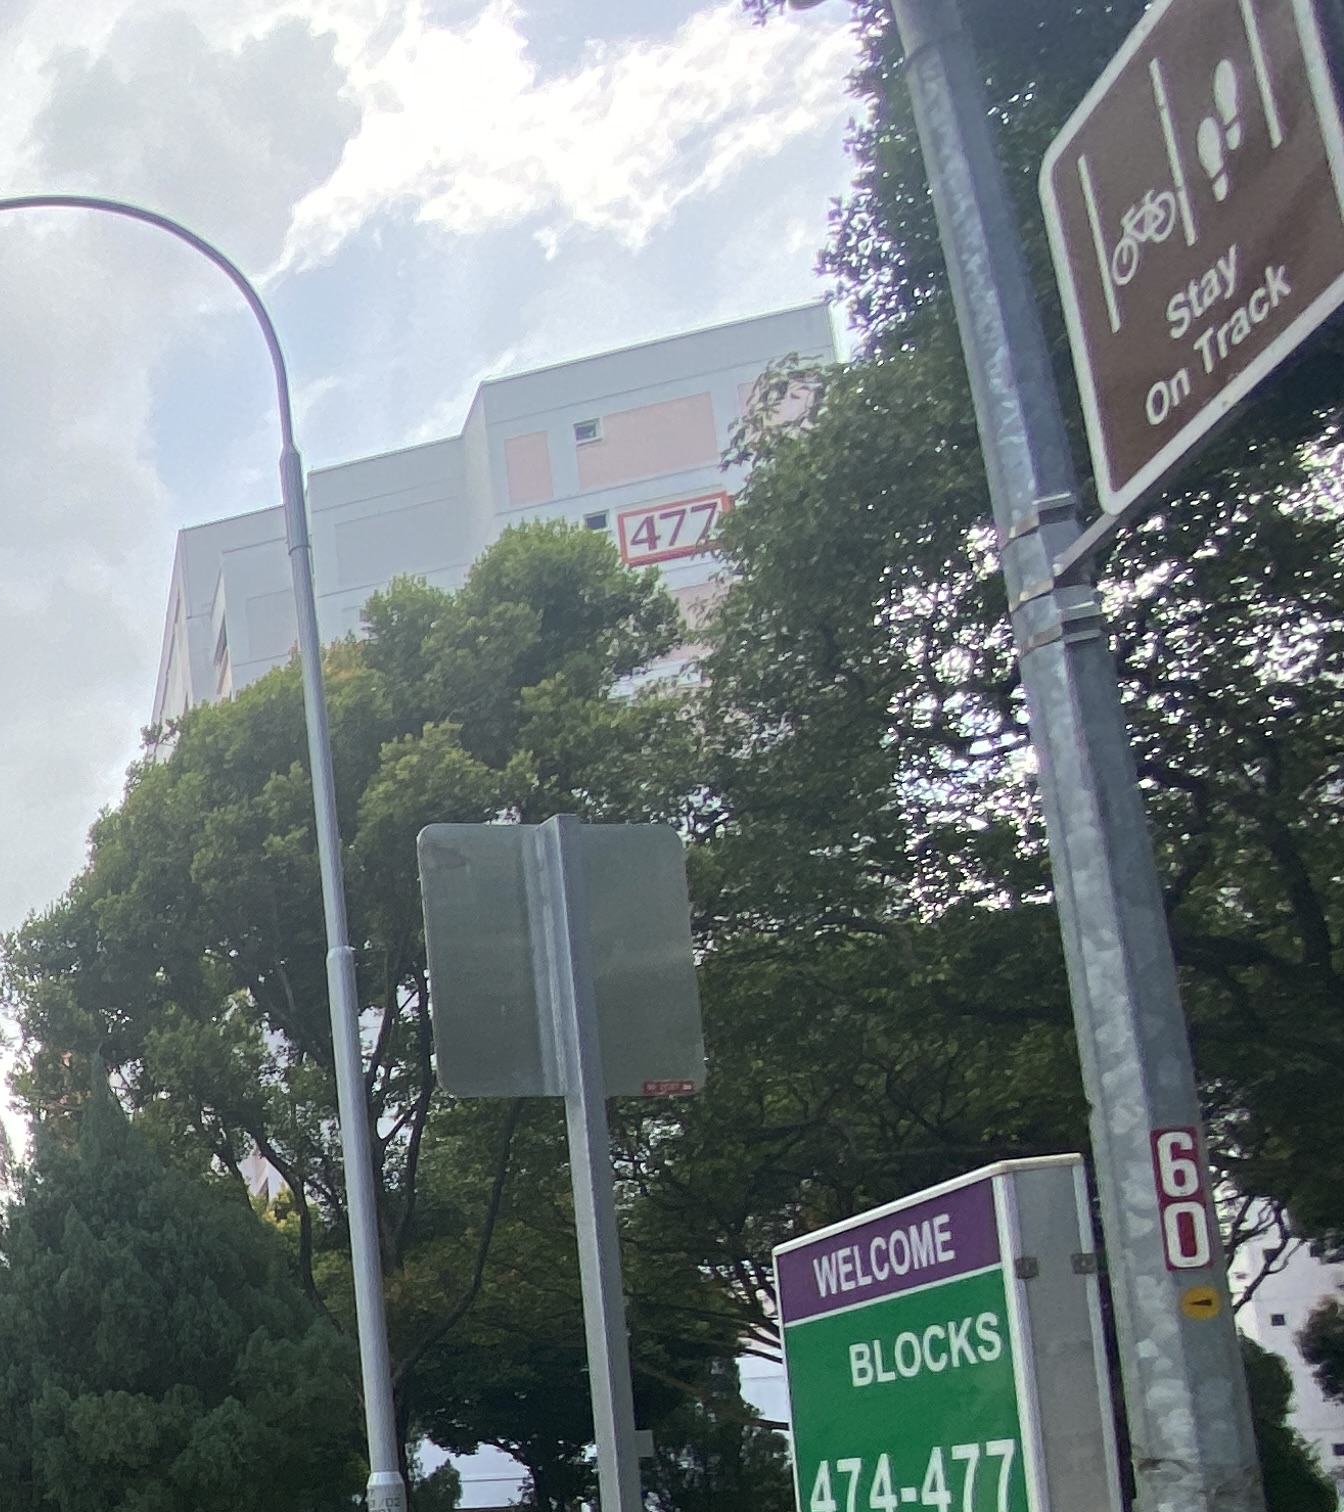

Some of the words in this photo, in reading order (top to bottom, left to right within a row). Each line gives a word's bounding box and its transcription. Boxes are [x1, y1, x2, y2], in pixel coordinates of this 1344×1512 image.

[1166, 243, 1241, 340] Stay
[1145, 366, 1192, 425] On
[1193, 265, 1293, 375] Track
[631, 503, 717, 550] 477
[813, 1214, 955, 1298] WELCOME
[849, 1311, 1003, 1388] BLOCKS
